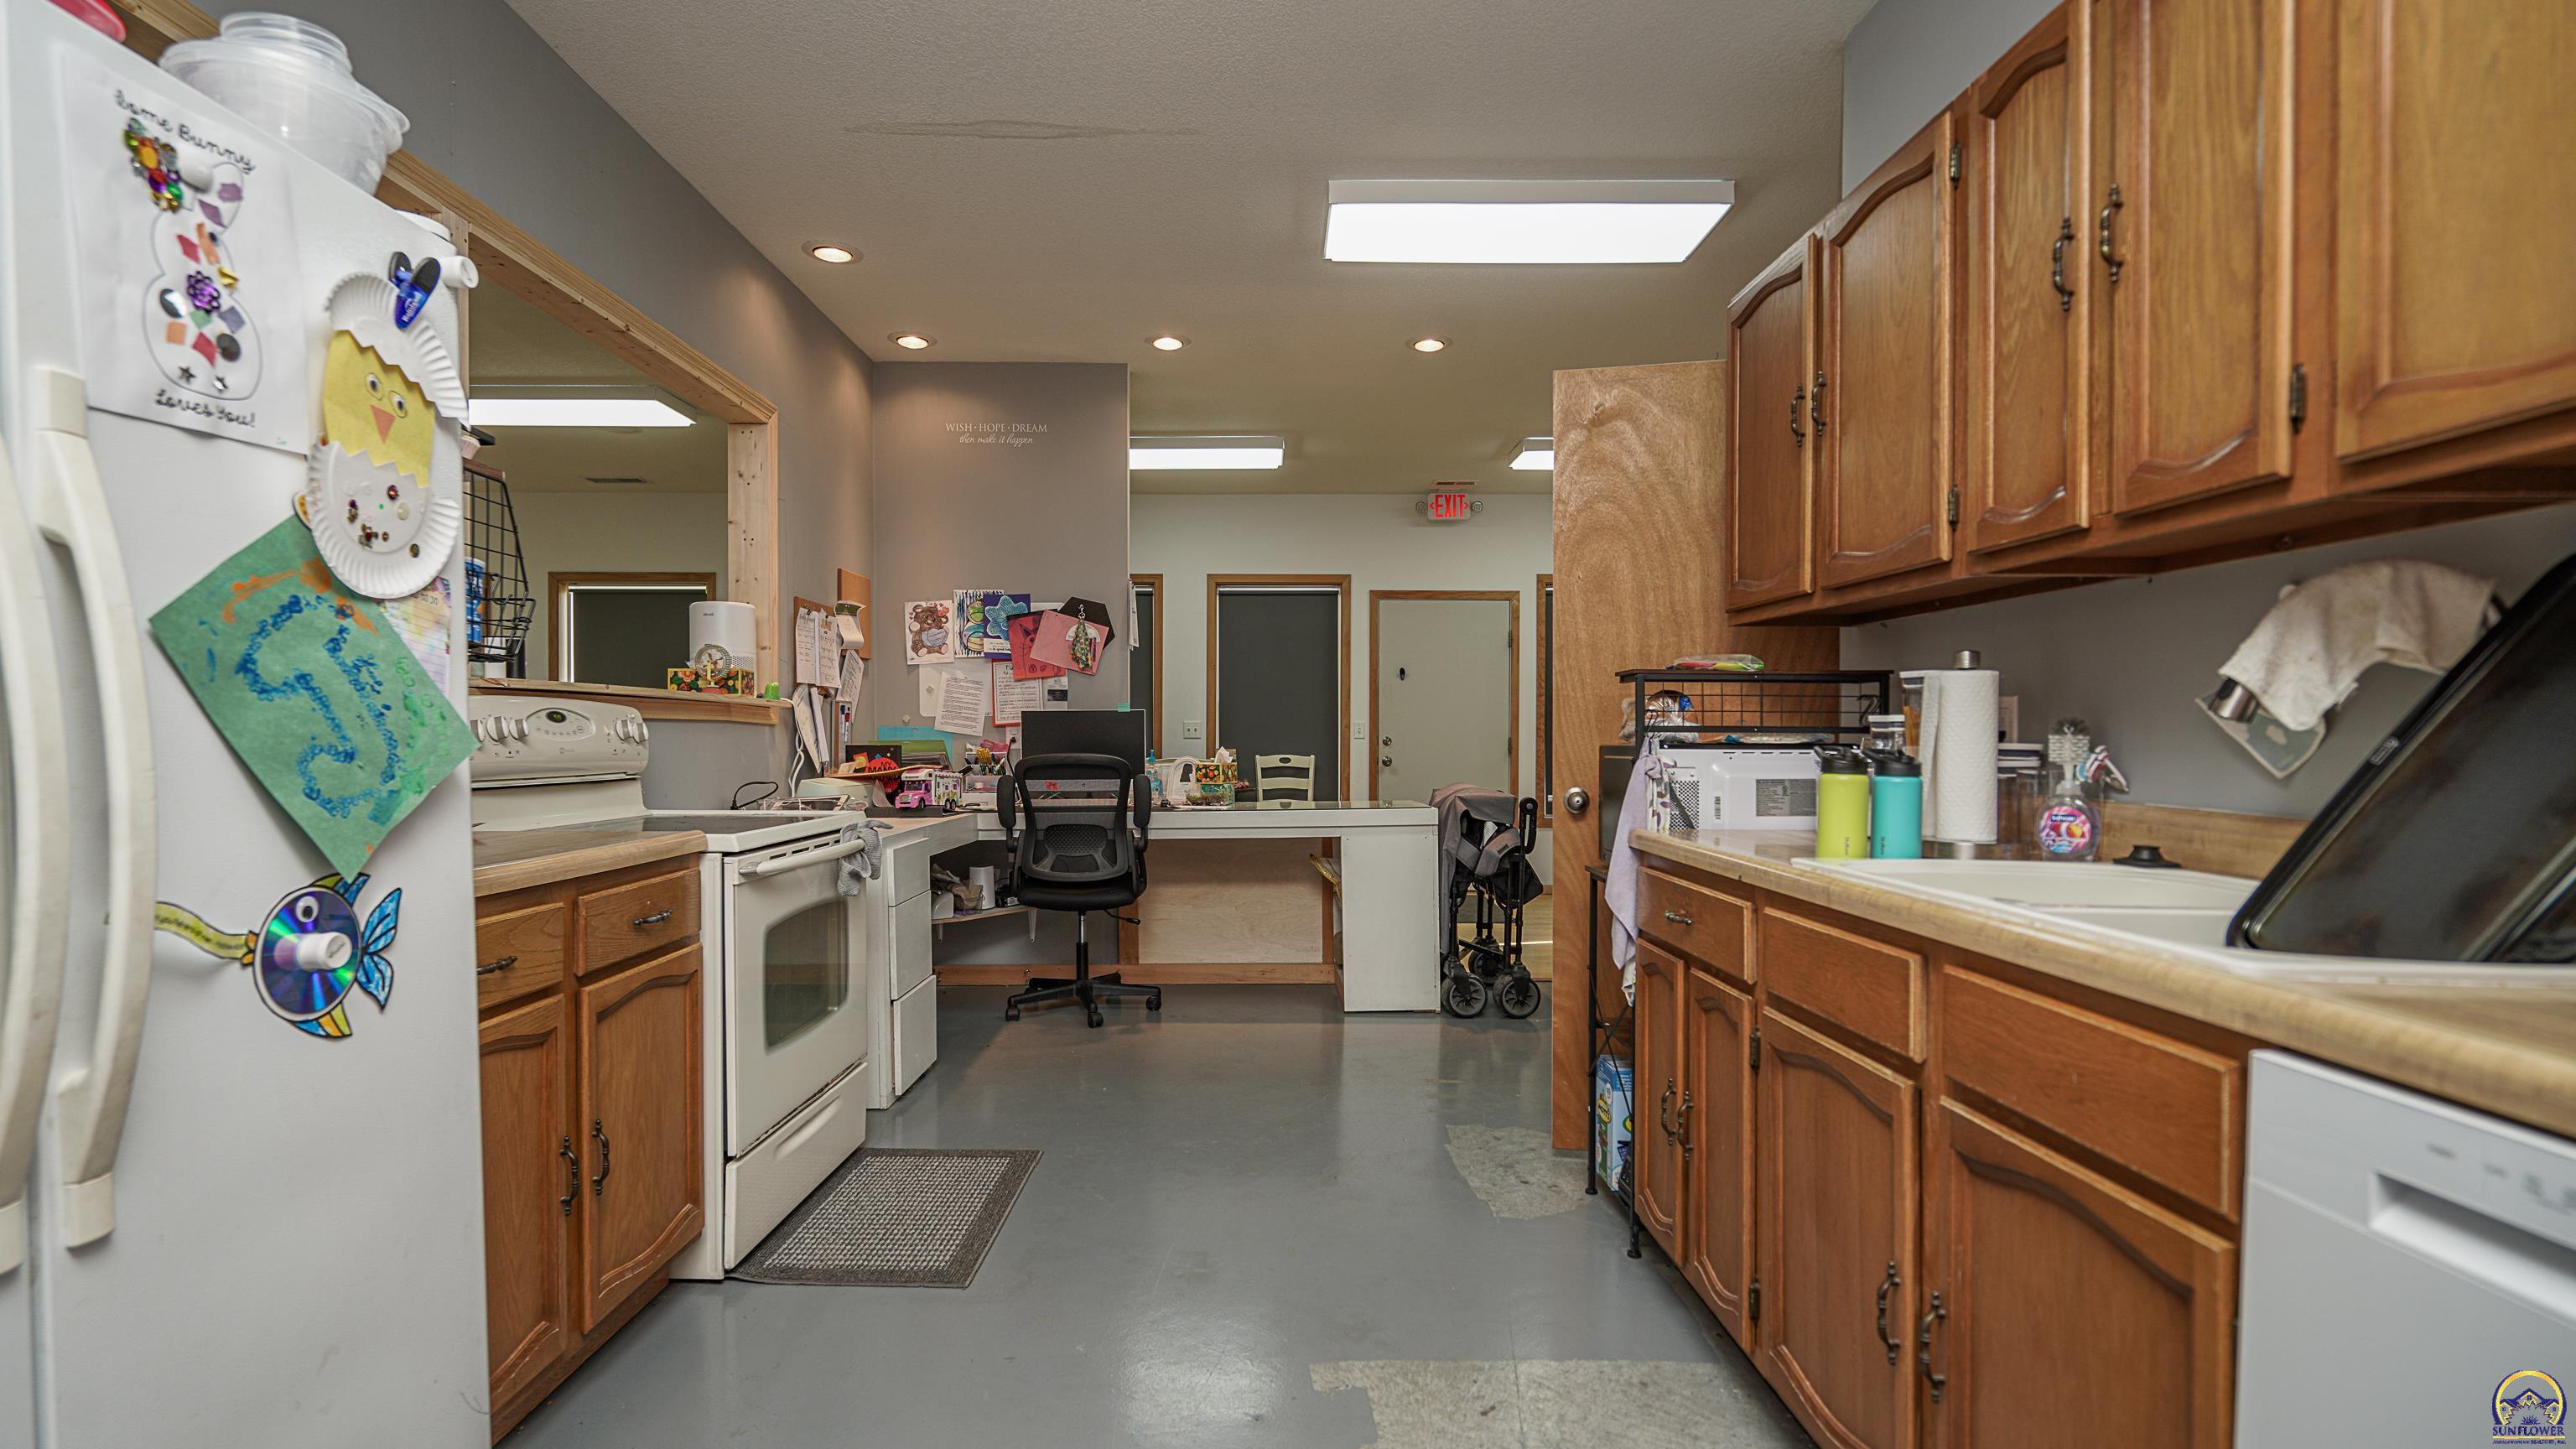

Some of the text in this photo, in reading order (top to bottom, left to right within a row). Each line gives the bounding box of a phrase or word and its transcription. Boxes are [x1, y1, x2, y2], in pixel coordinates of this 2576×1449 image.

[179, 123, 256, 174] Bunny
[945, 423, 1047, 433] WISH HOPE DREAM
[959, 433, 1033, 448] then make it happen
[1435, 494, 1466, 517] EXIT
